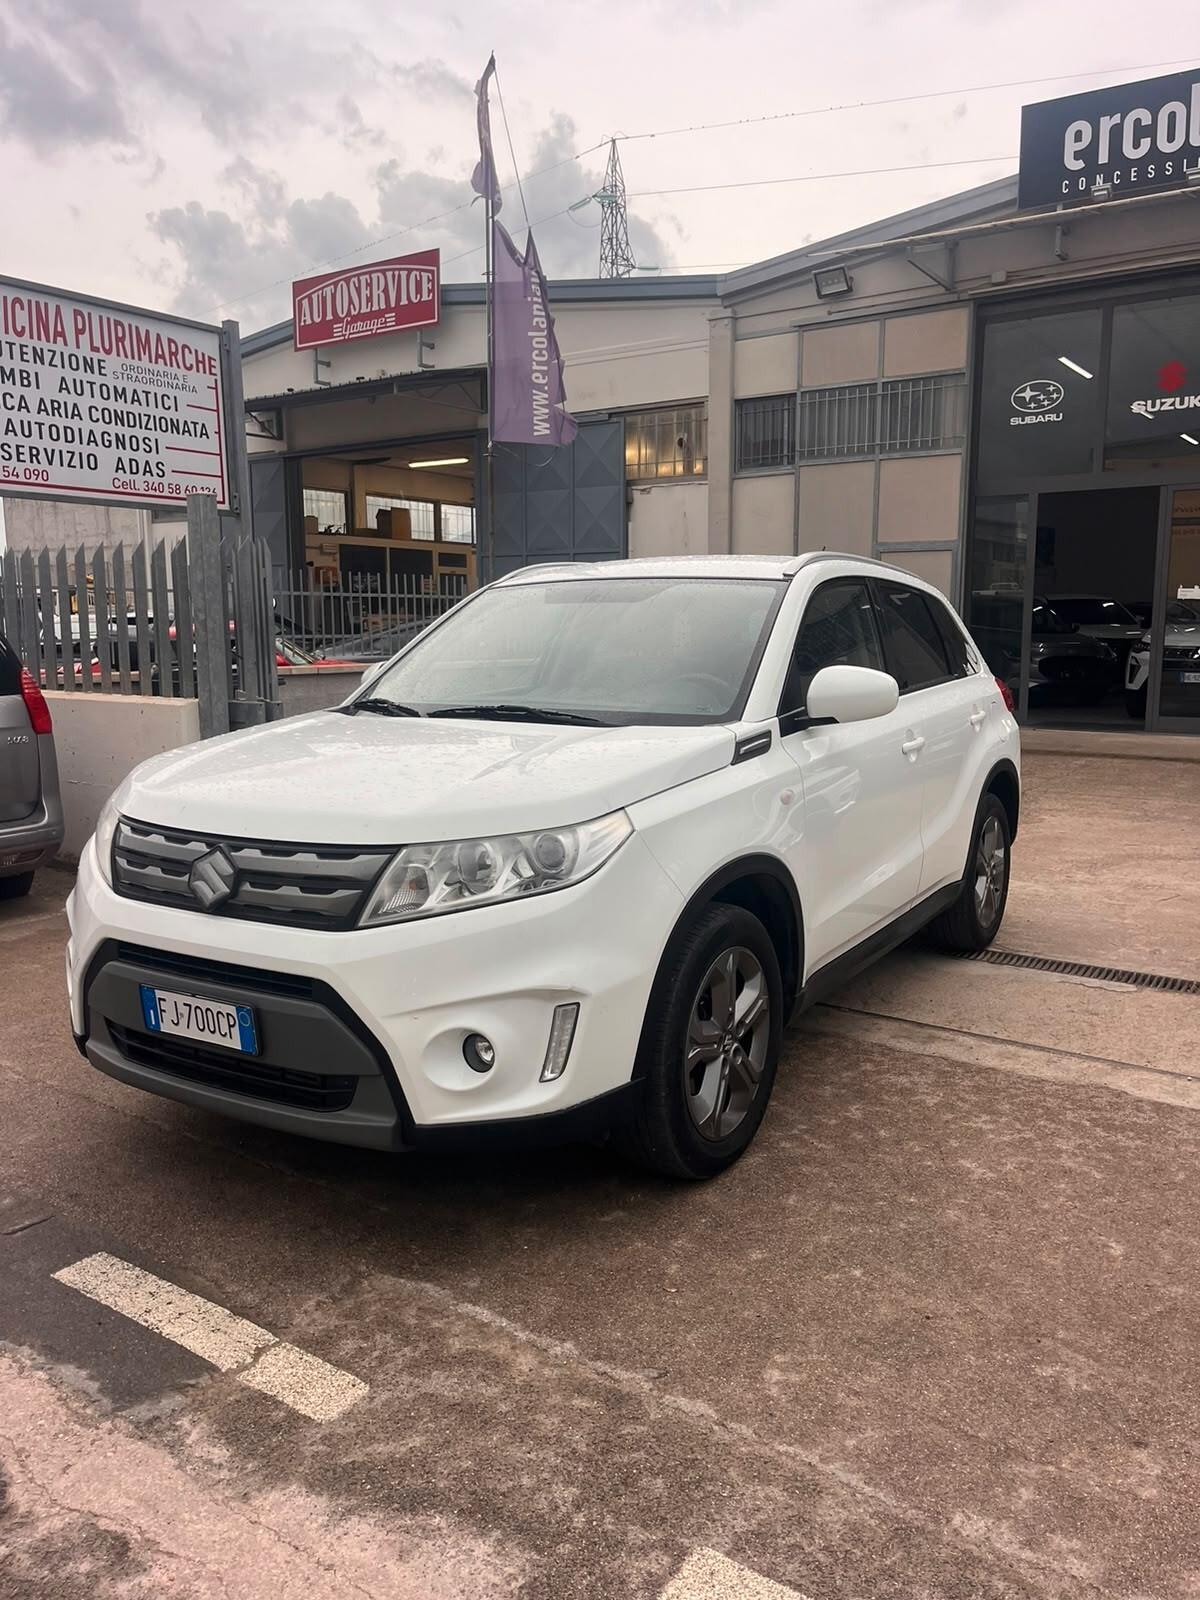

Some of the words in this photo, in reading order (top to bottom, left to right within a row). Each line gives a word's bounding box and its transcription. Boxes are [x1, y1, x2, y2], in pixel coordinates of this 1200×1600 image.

[1063, 83, 1200, 171] ercol
[1062, 158, 1200, 194] CONCESSI
[300, 270, 433, 326] AUTOSERVICE
[3, 295, 68, 347] ICINA
[73, 307, 218, 376] PLURIMARCHE
[341, 315, 387, 339] Garage
[0, 365, 40, 390] MBI
[58, 376, 179, 412] AUTOMATICI
[112, 370, 198, 394] STRAORDINARIA
[121, 362, 180, 382] ORDINARIA
[182, 374, 189, 383] E
[0, 391, 31, 414] CA
[37, 397, 83, 421] ARIA
[88, 405, 210, 440] CONDIZIONATA
[1010, 412, 1063, 426] SUBARU
[1131, 394, 1200, 414] SUZUK
[4, 417, 159, 455] AUTODIAGNOSI
[0, 442, 98, 471] SERVIZIO
[115, 456, 166, 478] ADAS
[2, 465, 20, 479] 54
[23, 467, 49, 482] 090
[112, 477, 140, 491] Cell.
[143, 480, 165, 494] 340
[167, 482, 181, 495] 58
